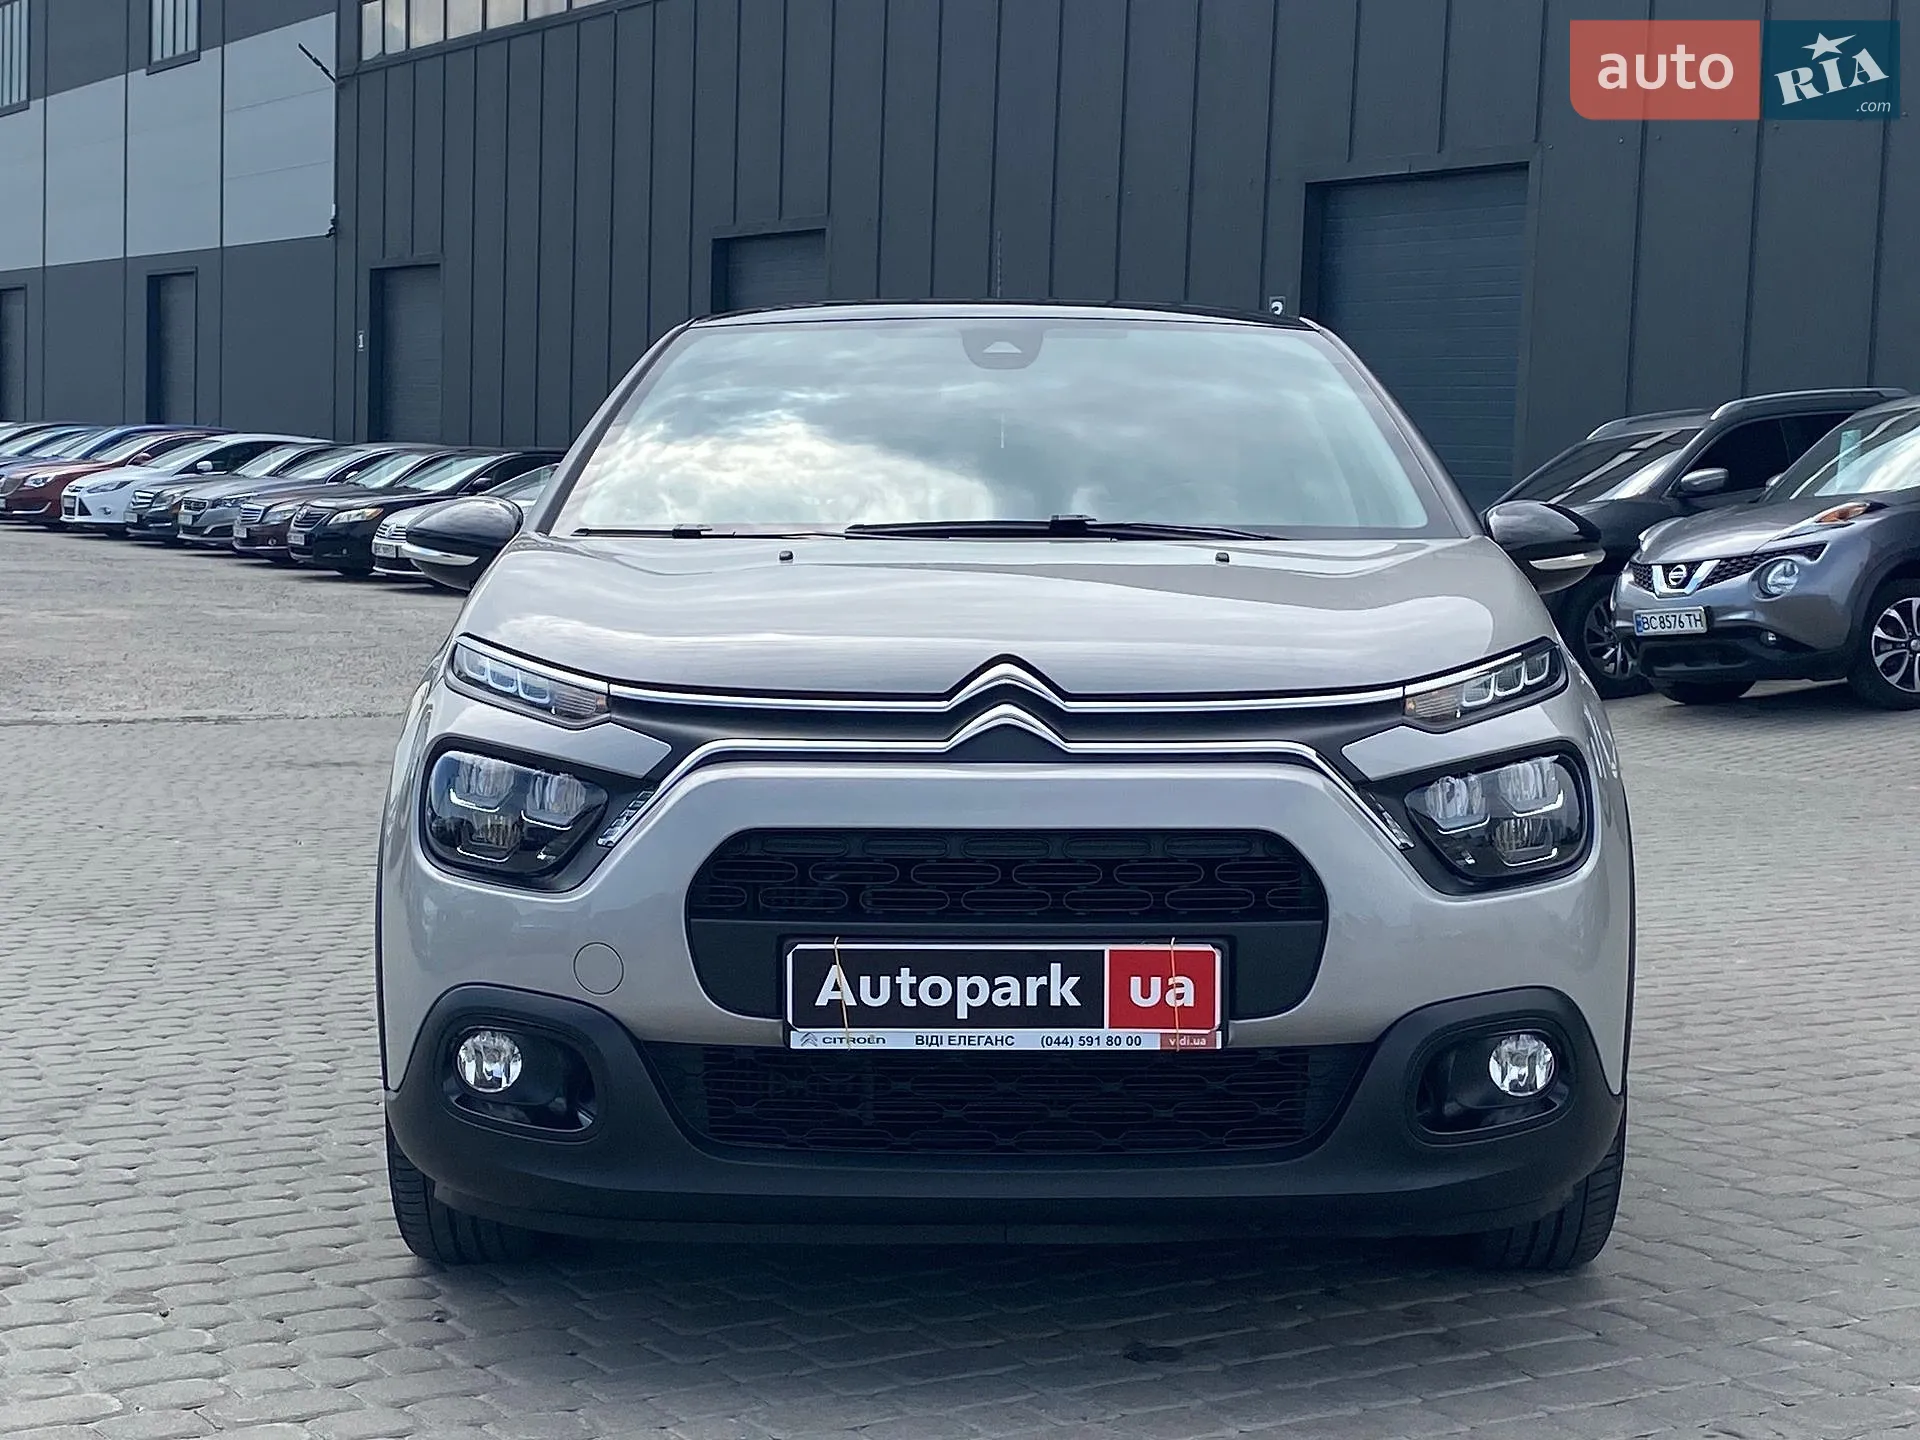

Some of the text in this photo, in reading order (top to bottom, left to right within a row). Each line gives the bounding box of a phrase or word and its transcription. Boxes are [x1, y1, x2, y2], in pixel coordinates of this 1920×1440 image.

[1642, 615, 1658, 630] BC
[1659, 614, 1685, 629] 8576
[1685, 613, 1704, 628] TH
[814, 964, 1196, 1019] Autopark ua
[915, 1035, 1015, 1047] ВІДІ ЕЛЕГАНС
[1040, 1035, 1142, 1048] (044) 591 80 00
[1169, 1036, 1207, 1046] vdi.ua
